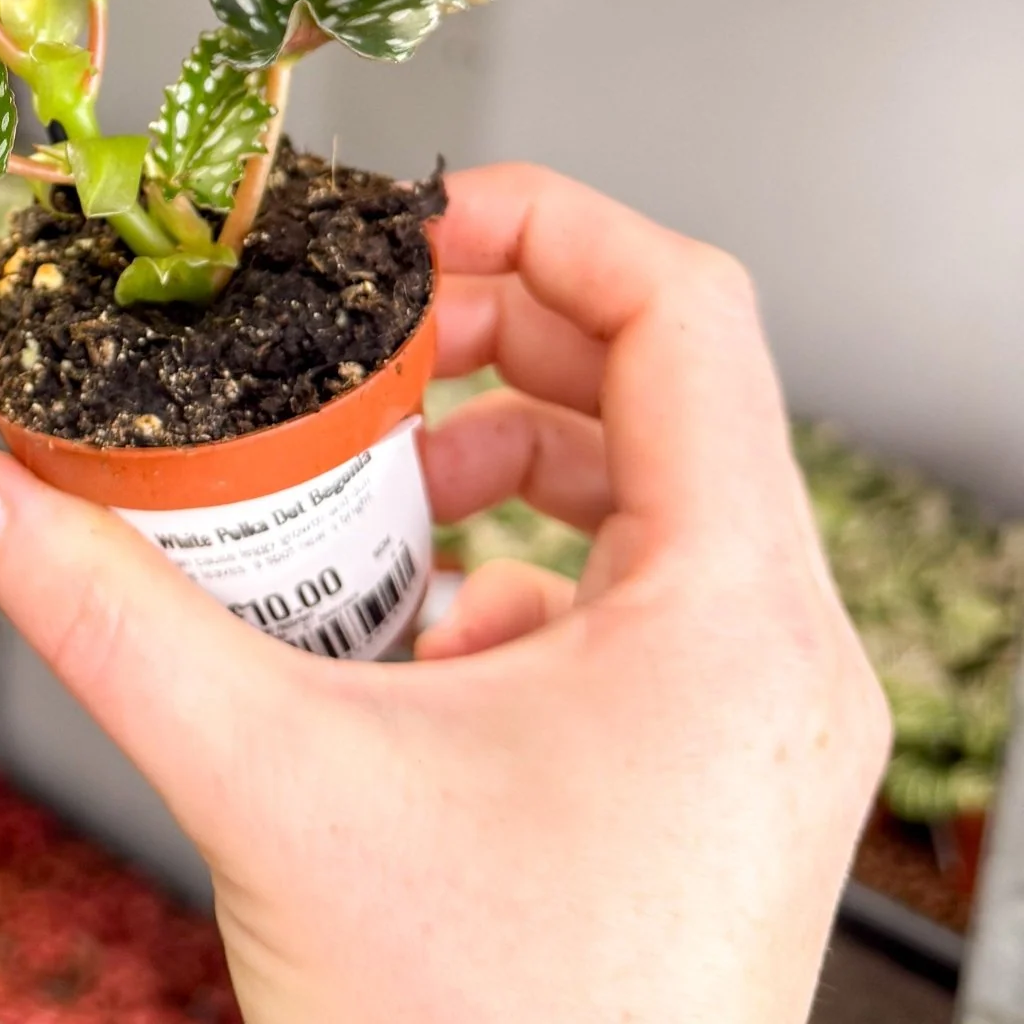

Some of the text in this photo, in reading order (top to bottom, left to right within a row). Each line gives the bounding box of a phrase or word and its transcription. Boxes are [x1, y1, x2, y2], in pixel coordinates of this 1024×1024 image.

[155, 532, 213, 549] White
[215, 520, 270, 544] Polka
[271, 500, 306, 526] Dot
[308, 450, 372, 507] Begonia
